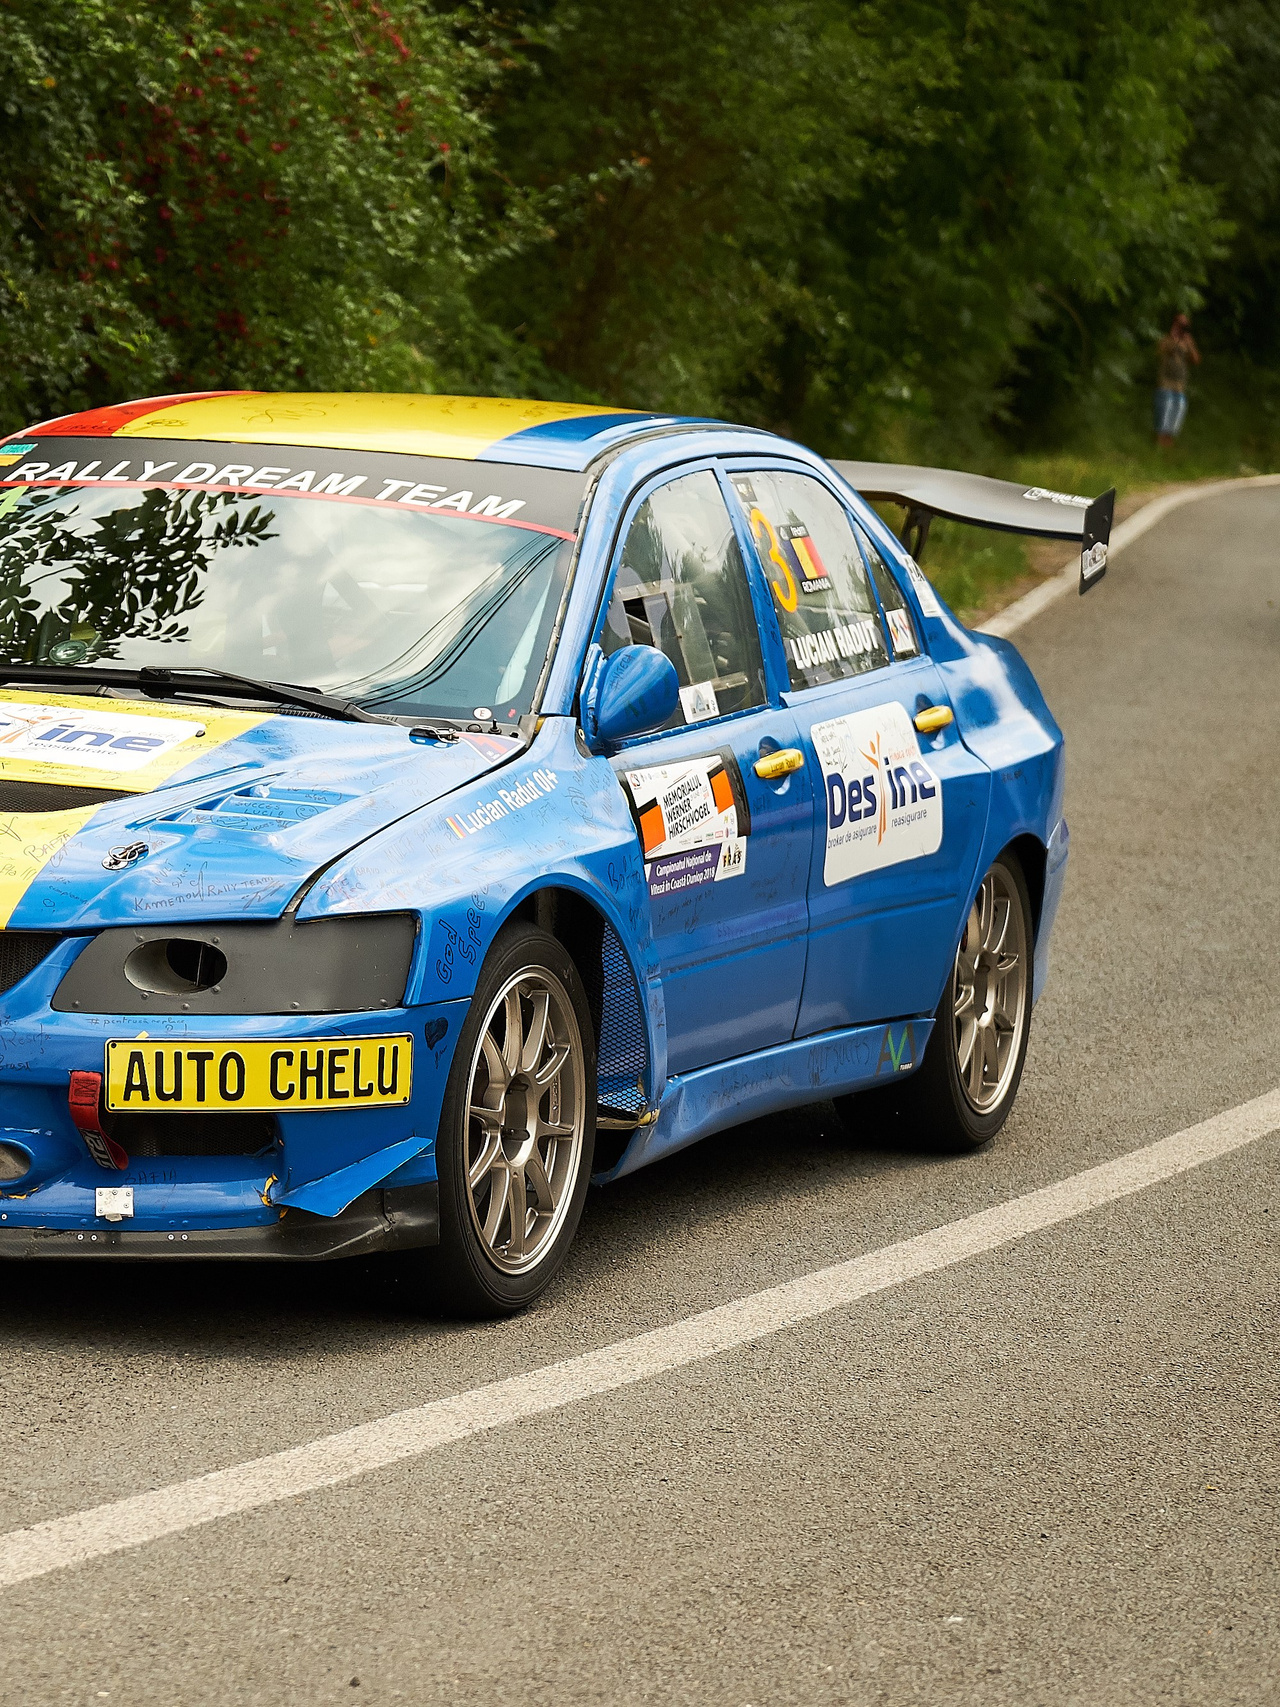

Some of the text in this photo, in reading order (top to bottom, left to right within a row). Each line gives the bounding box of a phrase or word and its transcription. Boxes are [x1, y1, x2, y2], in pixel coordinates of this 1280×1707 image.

[3, 461, 527, 518] RALLY DREAM TEAM
[750, 508, 798, 613] 3
[802, 578, 832, 593] ROMANIA
[789, 619, 879, 670] LUCIAN RADUT
[455, 801, 510, 835] Lucian
[498, 777, 544, 811] Radut
[663, 774, 702, 810] MEMORIALUL
[665, 798, 692, 825] WERNER
[668, 802, 711, 839] HIRSCHVOGEL
[891, 809, 928, 828] reasigurare
[827, 833, 845, 849] broker
[122, 1045, 400, 1102] AUTO CHELU
